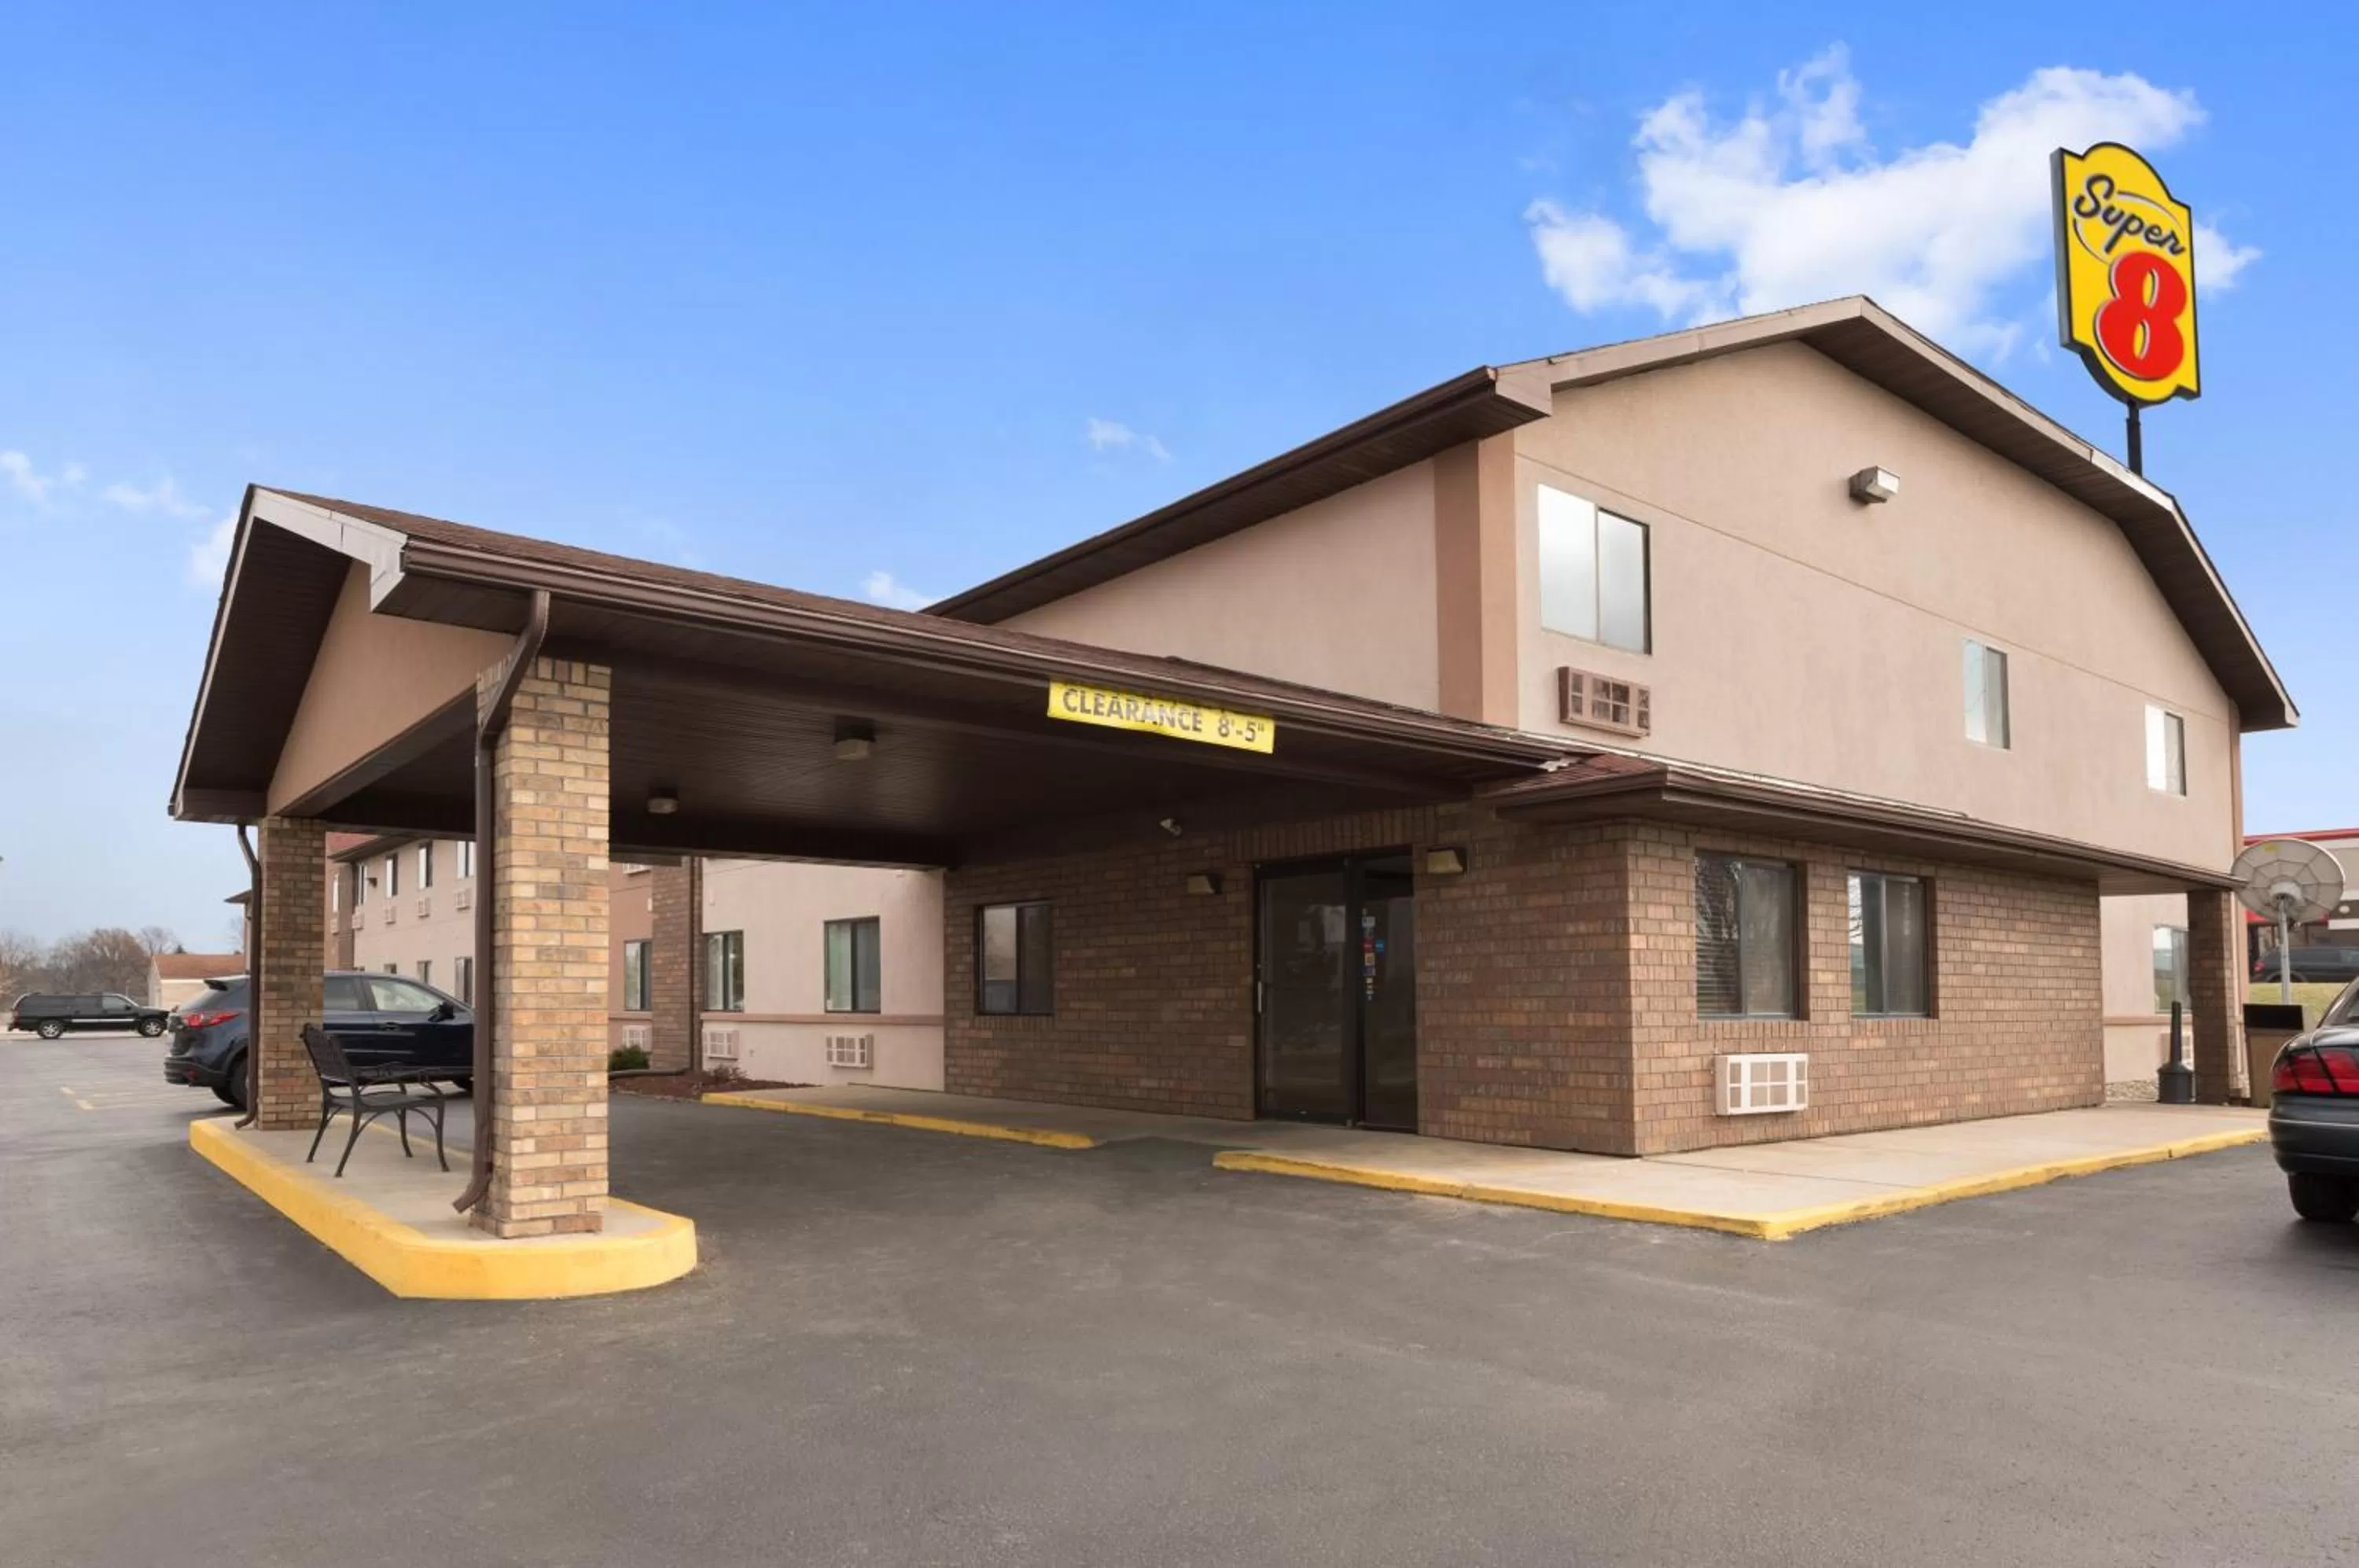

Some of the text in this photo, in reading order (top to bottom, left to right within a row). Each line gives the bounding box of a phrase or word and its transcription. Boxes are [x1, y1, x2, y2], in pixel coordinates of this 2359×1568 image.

[2074, 173, 2186, 255] Super
[2093, 251, 2187, 381] 8
[1062, 688, 1202, 732] CLEARANCE
